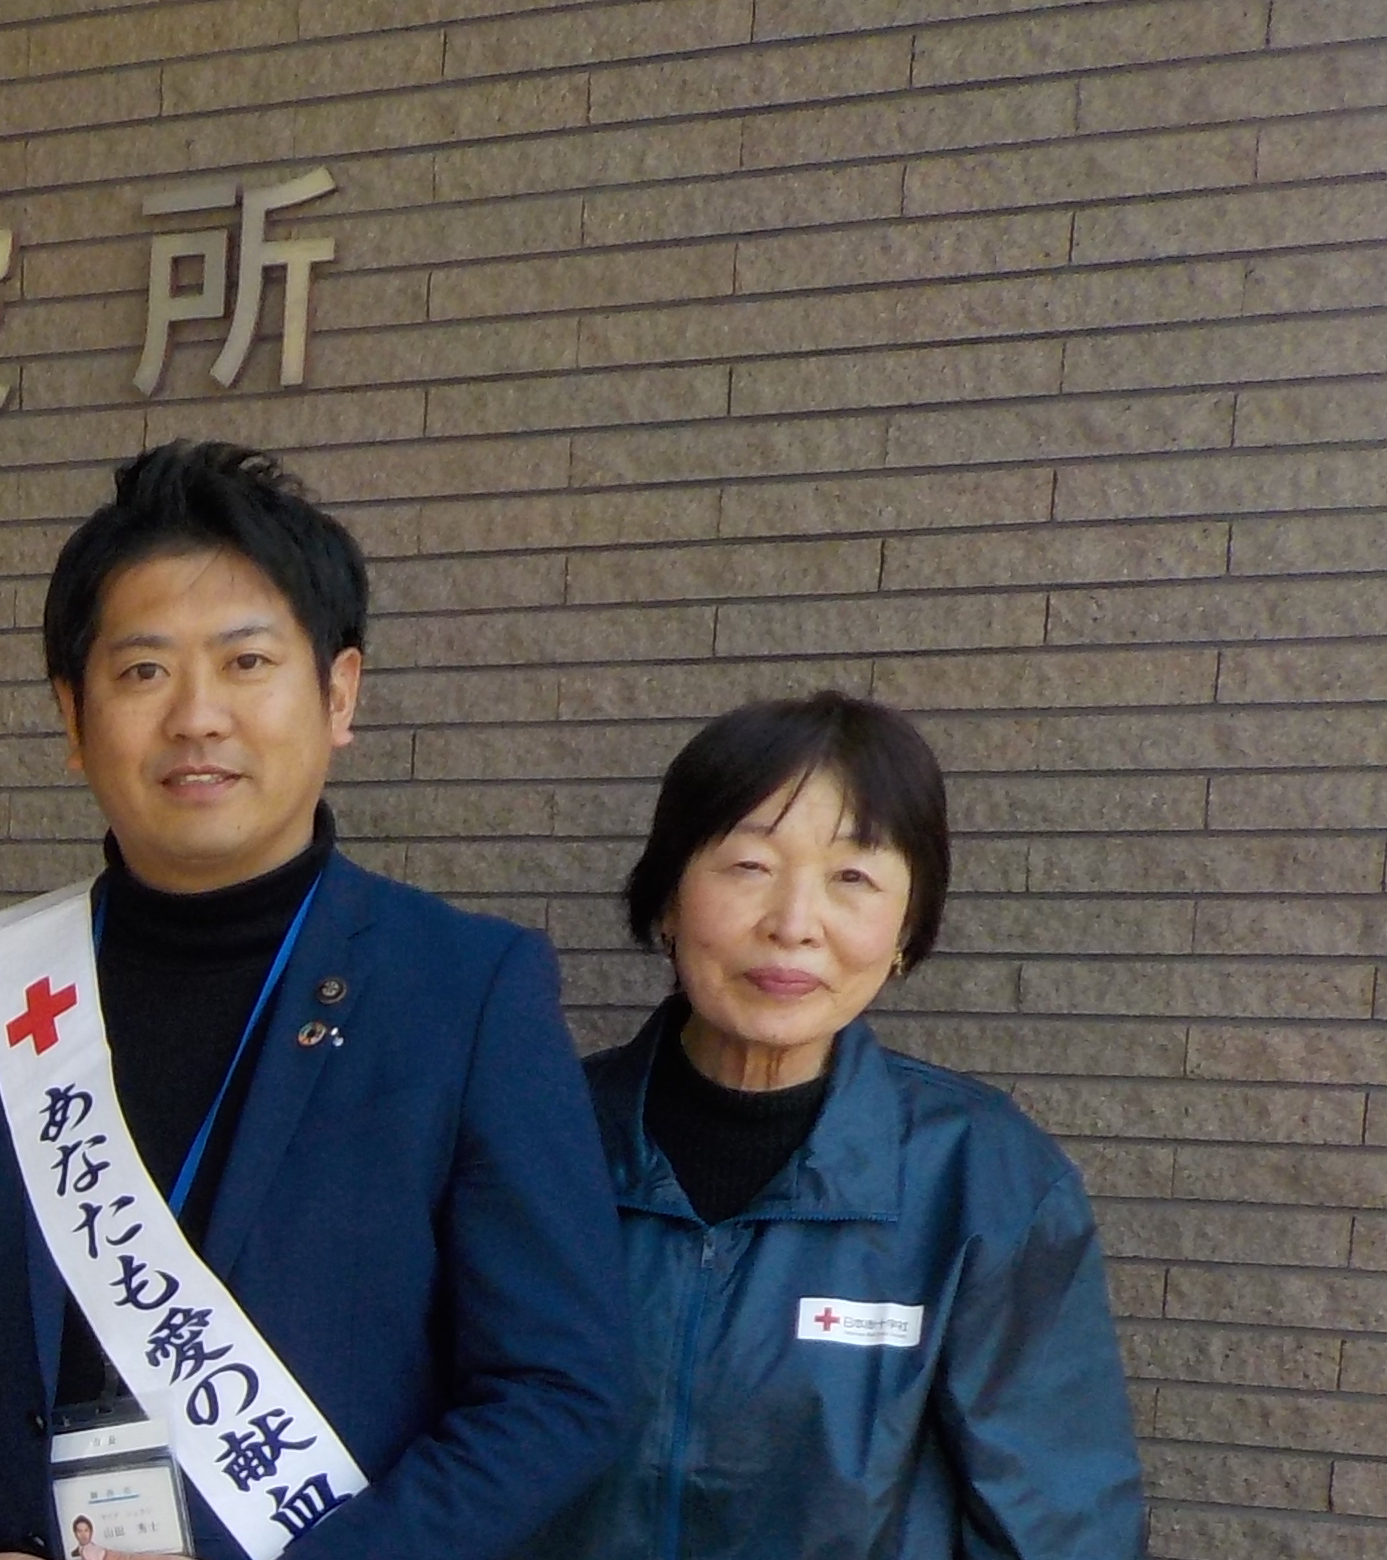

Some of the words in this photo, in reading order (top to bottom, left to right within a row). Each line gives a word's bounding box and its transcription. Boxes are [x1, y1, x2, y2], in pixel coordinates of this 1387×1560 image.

[37, 1083, 357, 1538] あなたも愛の献血
